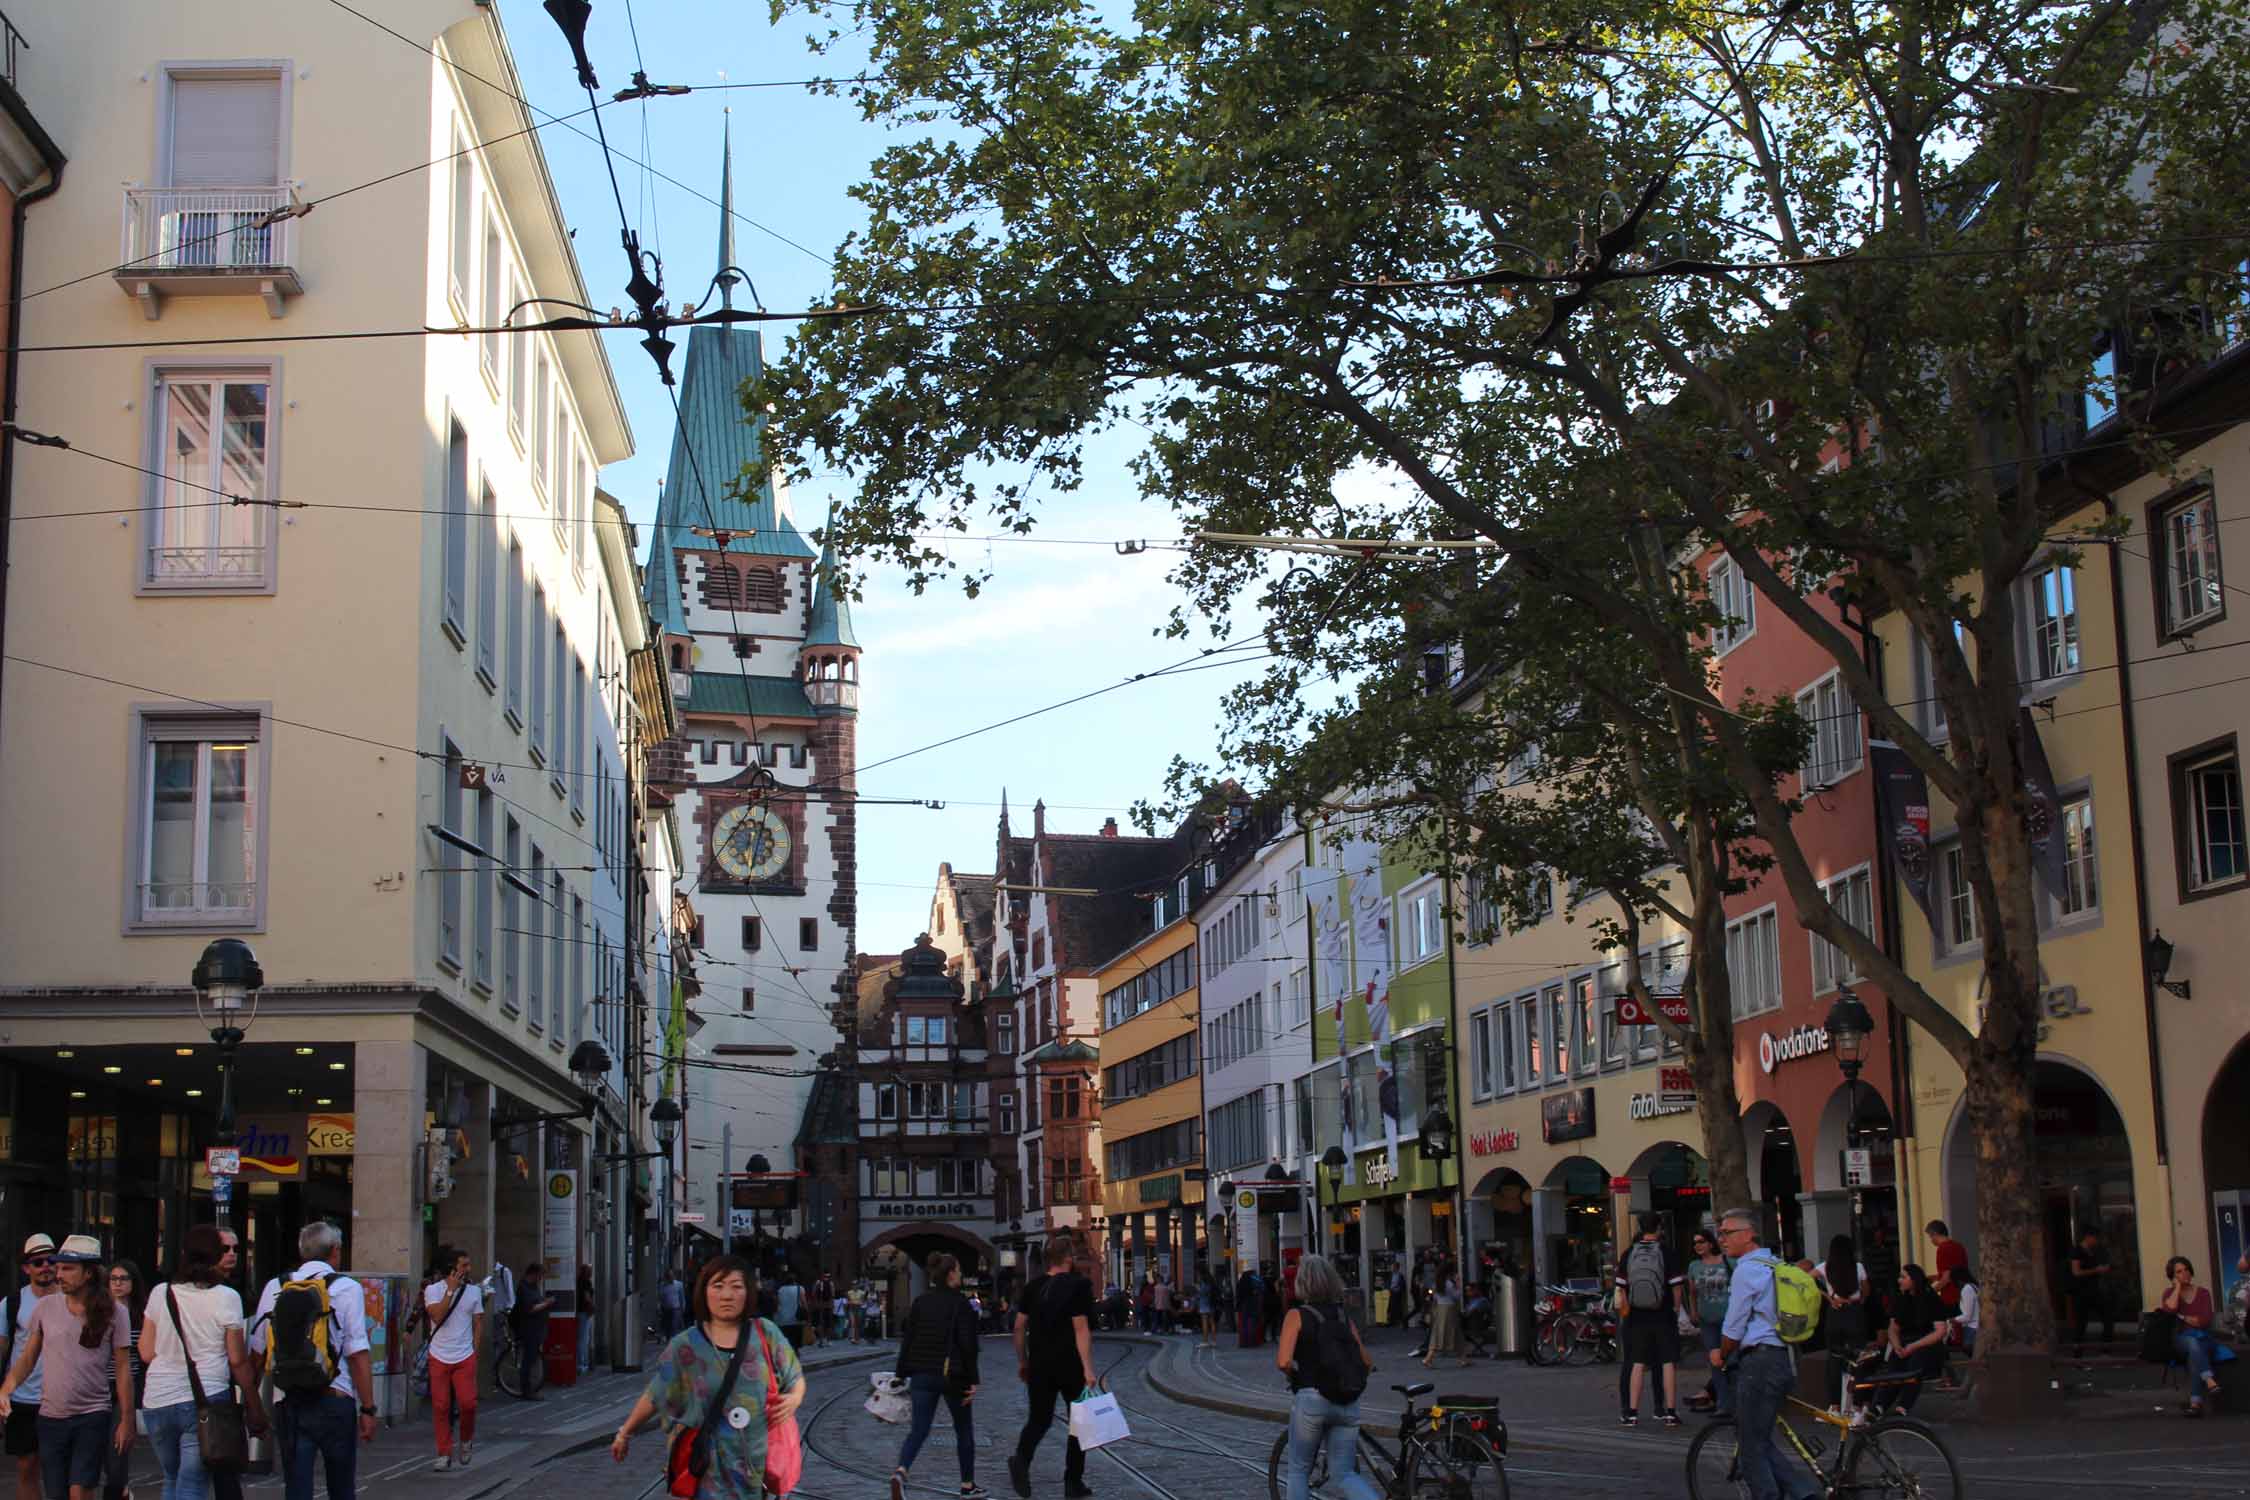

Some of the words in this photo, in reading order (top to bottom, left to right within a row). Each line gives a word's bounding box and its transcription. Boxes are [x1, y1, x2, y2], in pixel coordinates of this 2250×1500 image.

[1773, 1024, 1829, 1062] vodafone
[239, 1122, 289, 1155] dm
[878, 1202, 975, 1217] McDonald's
